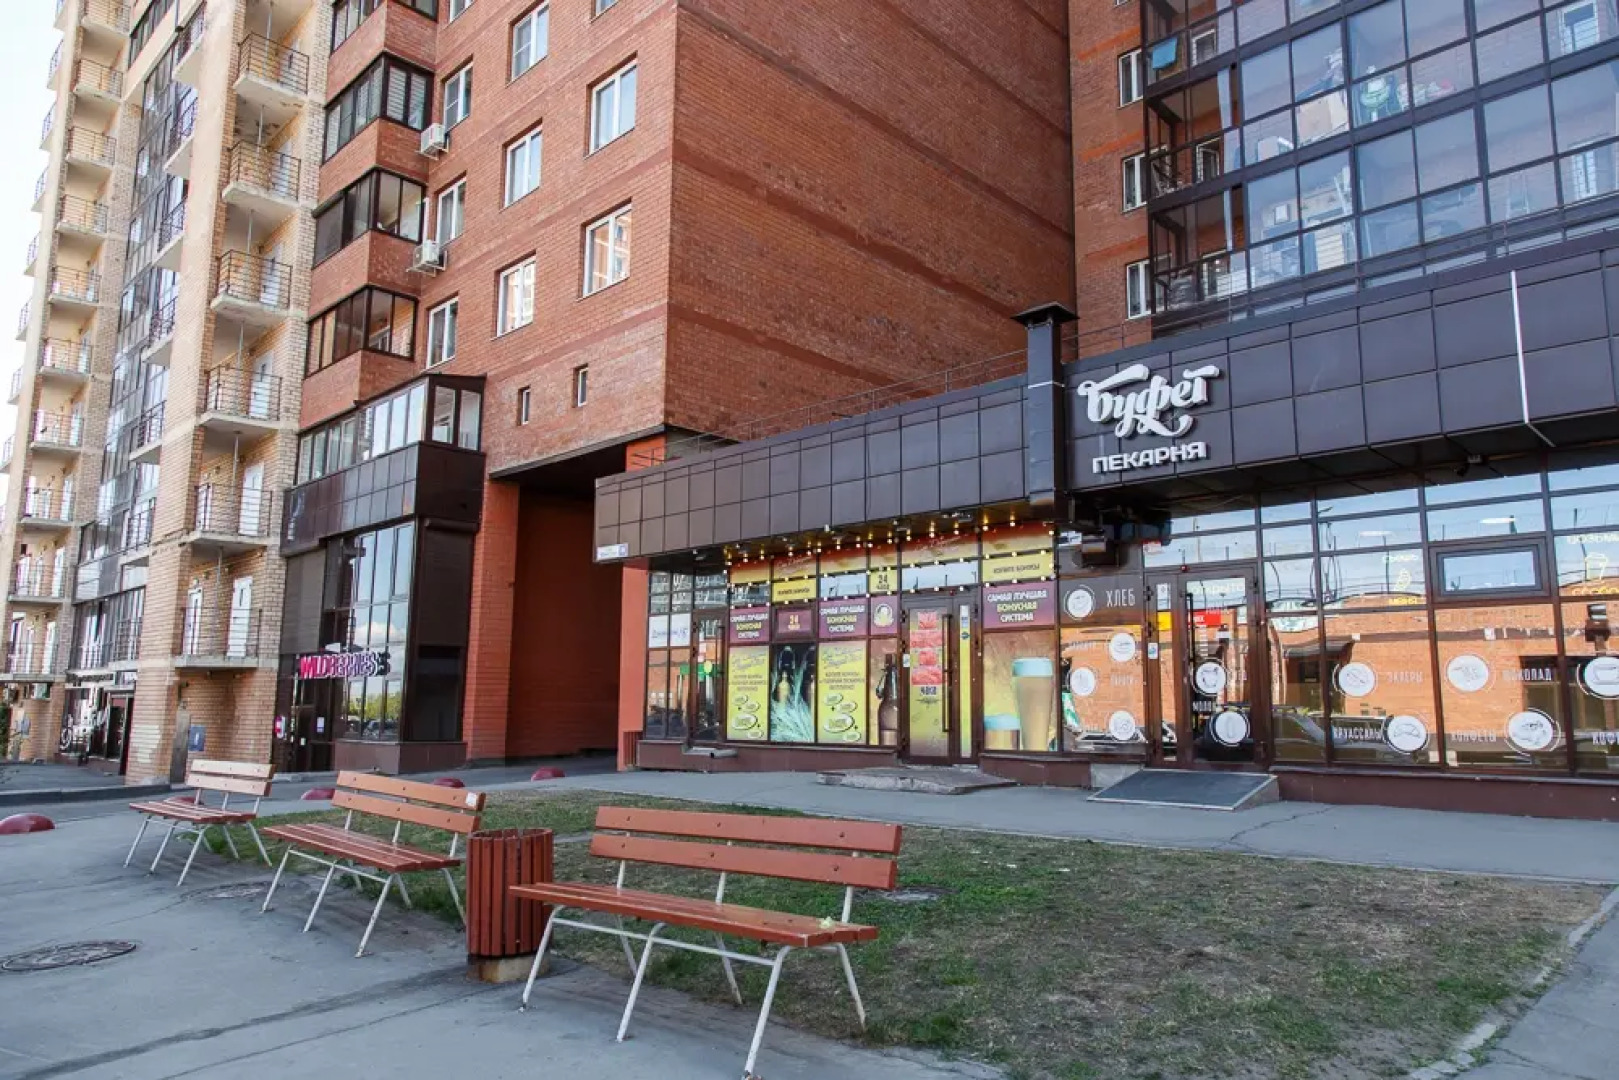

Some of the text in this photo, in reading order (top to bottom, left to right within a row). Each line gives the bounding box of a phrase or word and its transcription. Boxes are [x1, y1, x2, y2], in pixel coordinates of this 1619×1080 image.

[1092, 441, 1207, 474] ПЕКАРНЯ
[878, 574, 888, 584] 24
[987, 589, 1047, 602] САМАЯ ЛУЧШАЯ
[1105, 588, 1136, 607] ХЛЕБ
[820, 605, 865, 615] САМАЯ ЛУЧШАЯ
[996, 601, 1038, 613] БОНУСНАЯ
[826, 615, 857, 624] БОНУСНАЯ
[1000, 612, 1034, 623] СИСТЕМА
[736, 622, 762, 631] БОНУСНАЯ
[828, 624, 855, 633] СИСТЕМА
[738, 631, 759, 639] СИСТЕМА
